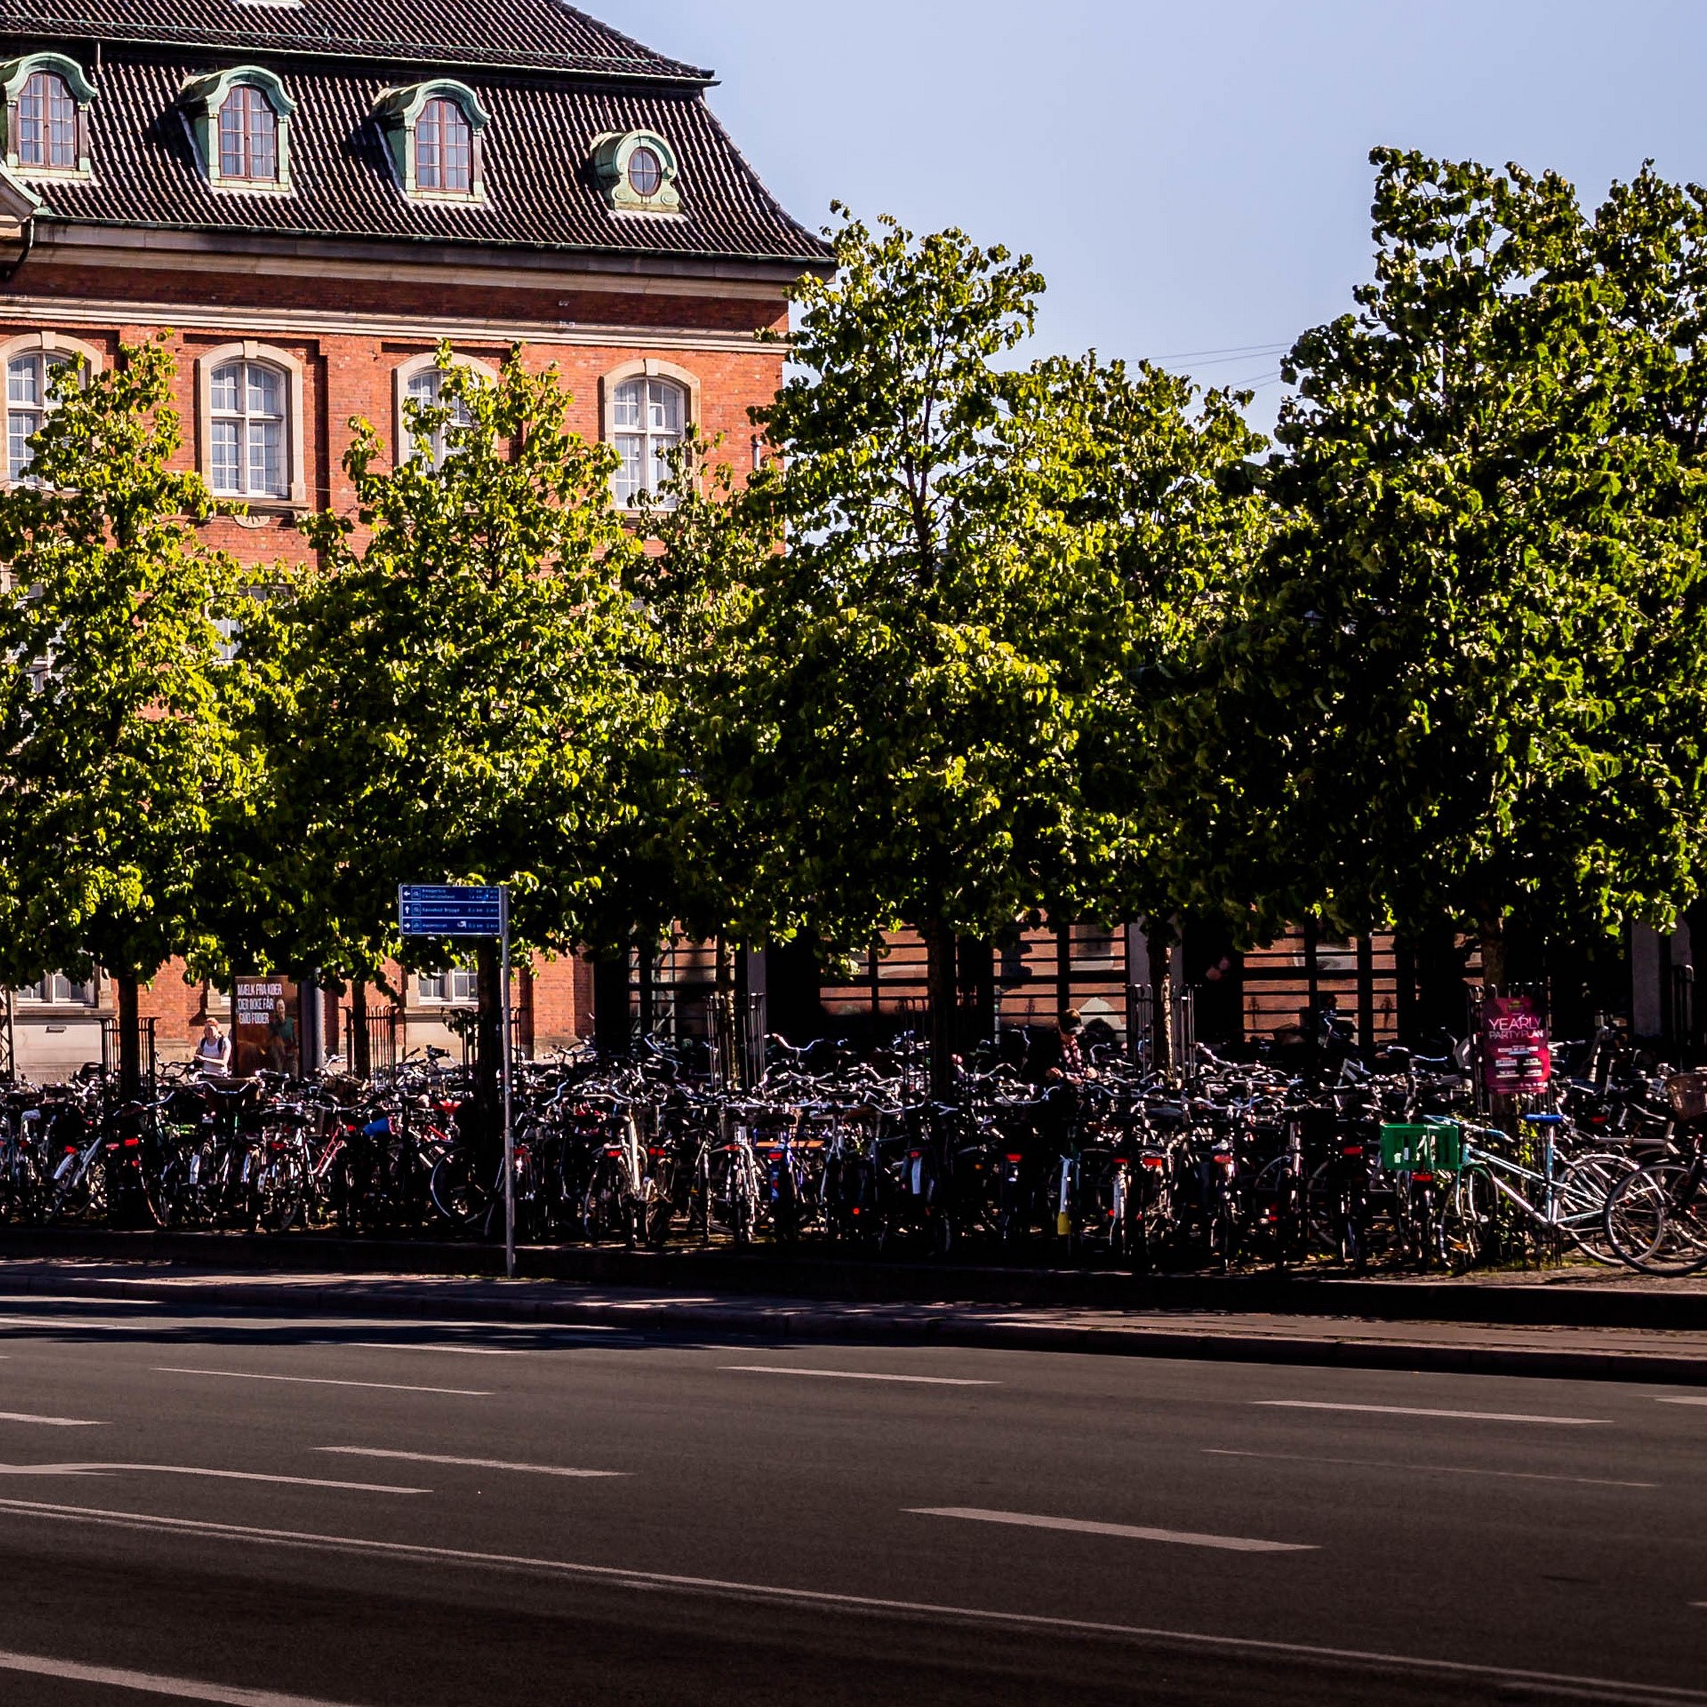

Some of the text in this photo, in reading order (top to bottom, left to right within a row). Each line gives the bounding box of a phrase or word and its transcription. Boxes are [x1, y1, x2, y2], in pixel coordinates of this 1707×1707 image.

[1488, 1016, 1542, 1031] YEARLY
[1489, 1029, 1544, 1039] PARTY PLAN
